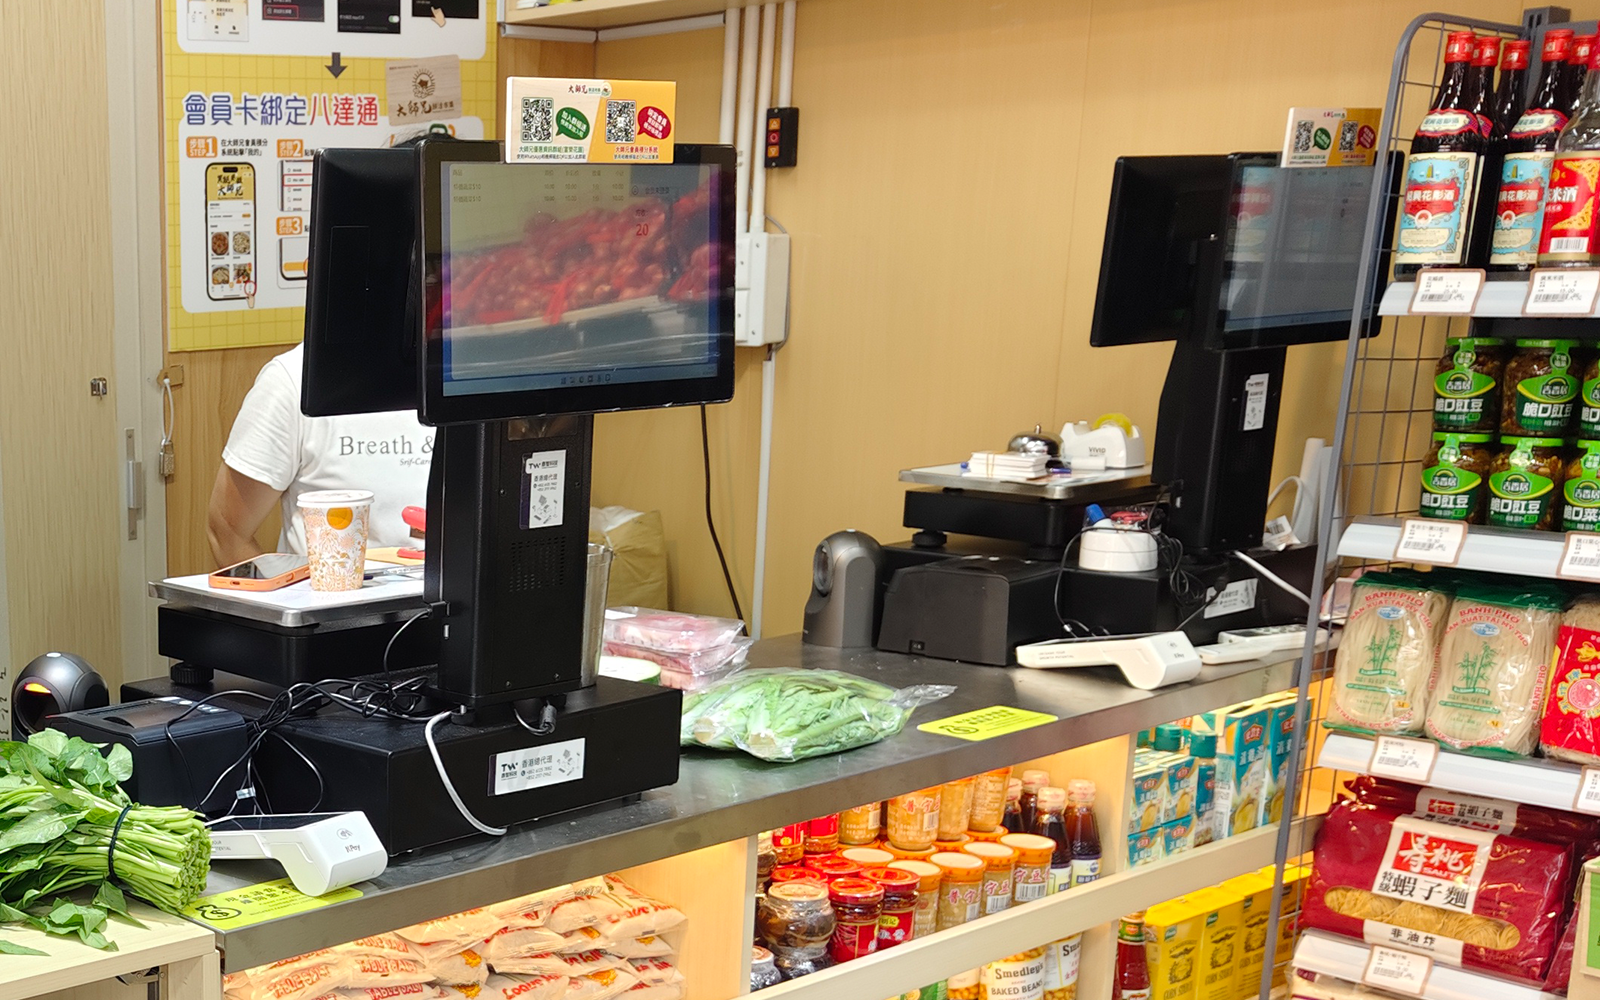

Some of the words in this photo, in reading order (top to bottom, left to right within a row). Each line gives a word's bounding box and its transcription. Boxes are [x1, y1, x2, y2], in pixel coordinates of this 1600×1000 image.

[184, 94, 379, 126] 會員卡綁定八達通
[396, 99, 433, 118] 大師兄
[189, 148, 206, 157] STEP
[205, 138, 215, 157] 1
[293, 140, 302, 158] 2
[293, 218, 301, 234] 3
[636, 223, 649, 236] 20
[1435, 398, 1483, 413] 脆口豇豆
[1522, 402, 1573, 418] 脆口豇豆
[339, 434, 413, 456] Breath
[421, 435, 434, 454] &
[1421, 492, 1469, 509] 脆口豇豆
[1490, 499, 1541, 515] 脆口豇豆
[1563, 505, 1600, 522] 脆口菜
[1392, 873, 1469, 909] 蝦子麵
[1390, 928, 1436, 946] 非油炸
[994, 962, 1044, 980] Smedley's
[991, 987, 1020, 996] BAKED
[1021, 980, 1044, 994] BEANS
